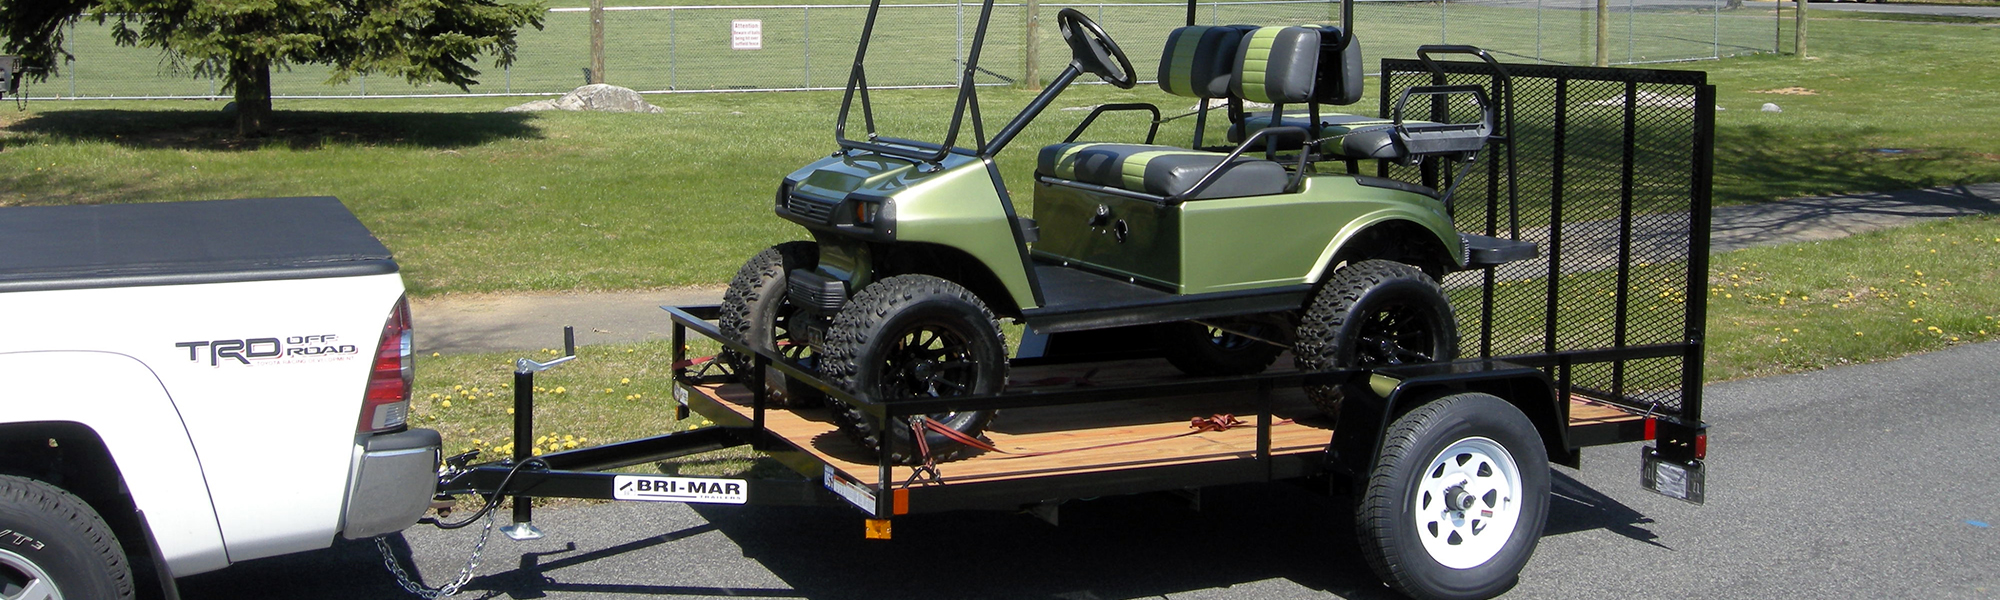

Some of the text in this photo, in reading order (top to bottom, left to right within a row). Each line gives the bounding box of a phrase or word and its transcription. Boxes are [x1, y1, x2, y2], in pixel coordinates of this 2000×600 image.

[286, 334, 336, 345] OFF
[175, 338, 281, 367] TRD
[286, 345, 357, 356] ROAD
[637, 479, 741, 495] BRI-MAR
